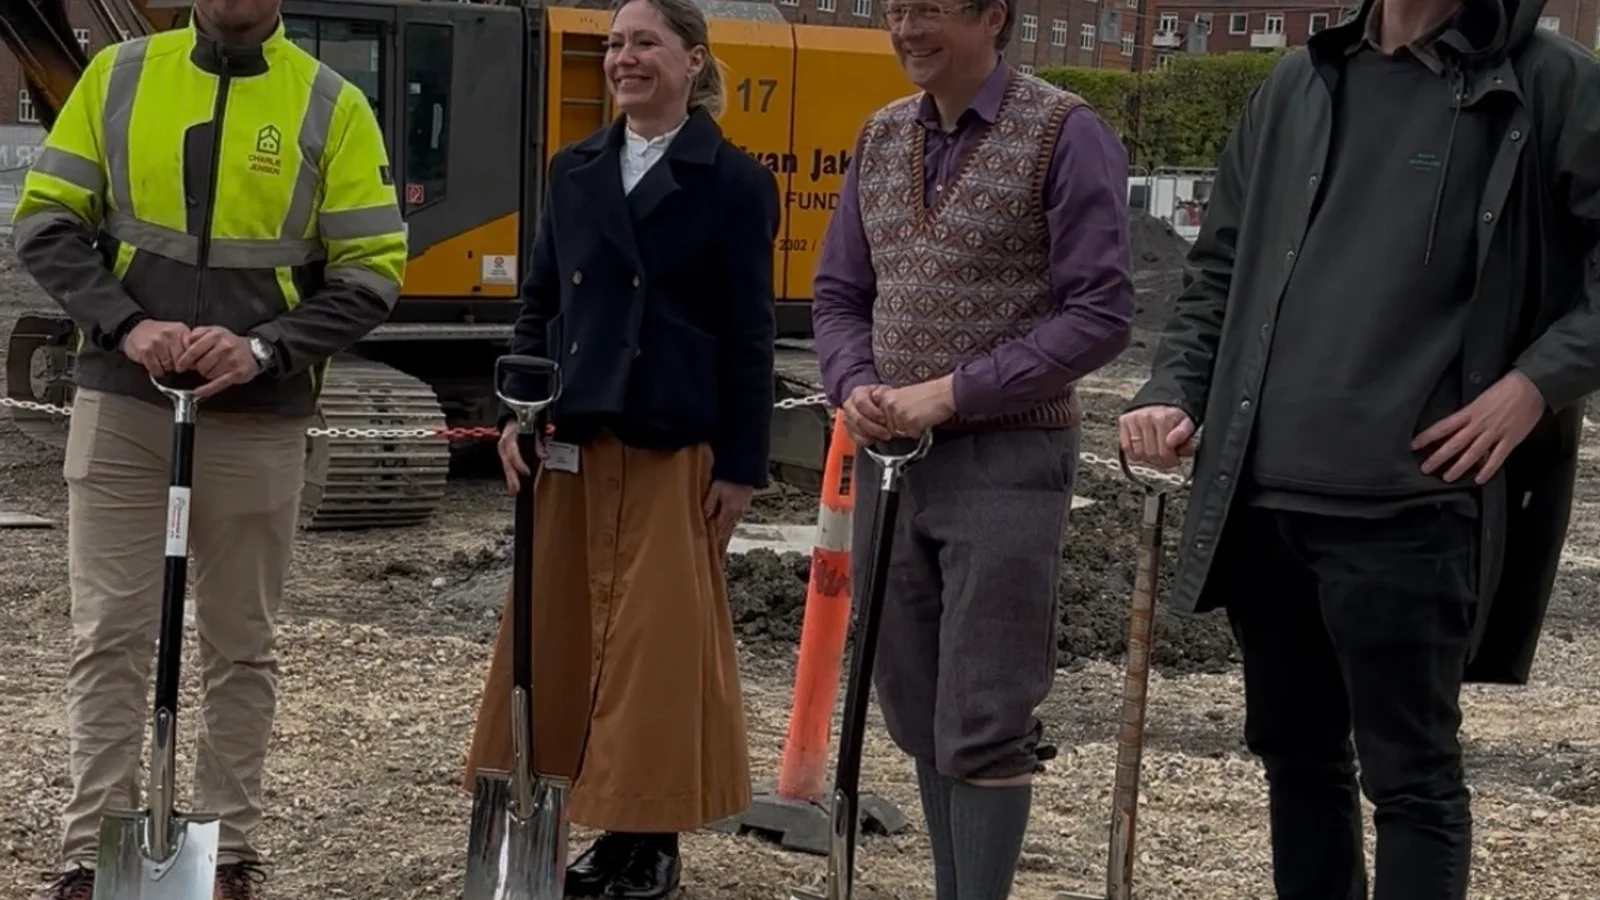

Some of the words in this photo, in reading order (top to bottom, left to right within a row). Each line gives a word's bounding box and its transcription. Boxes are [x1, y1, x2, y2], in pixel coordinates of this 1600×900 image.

[737, 78, 778, 112] 17
[248, 155, 281, 167] CHARLIE
[249, 163, 280, 175] JENSEN
[740, 145, 797, 173] van
